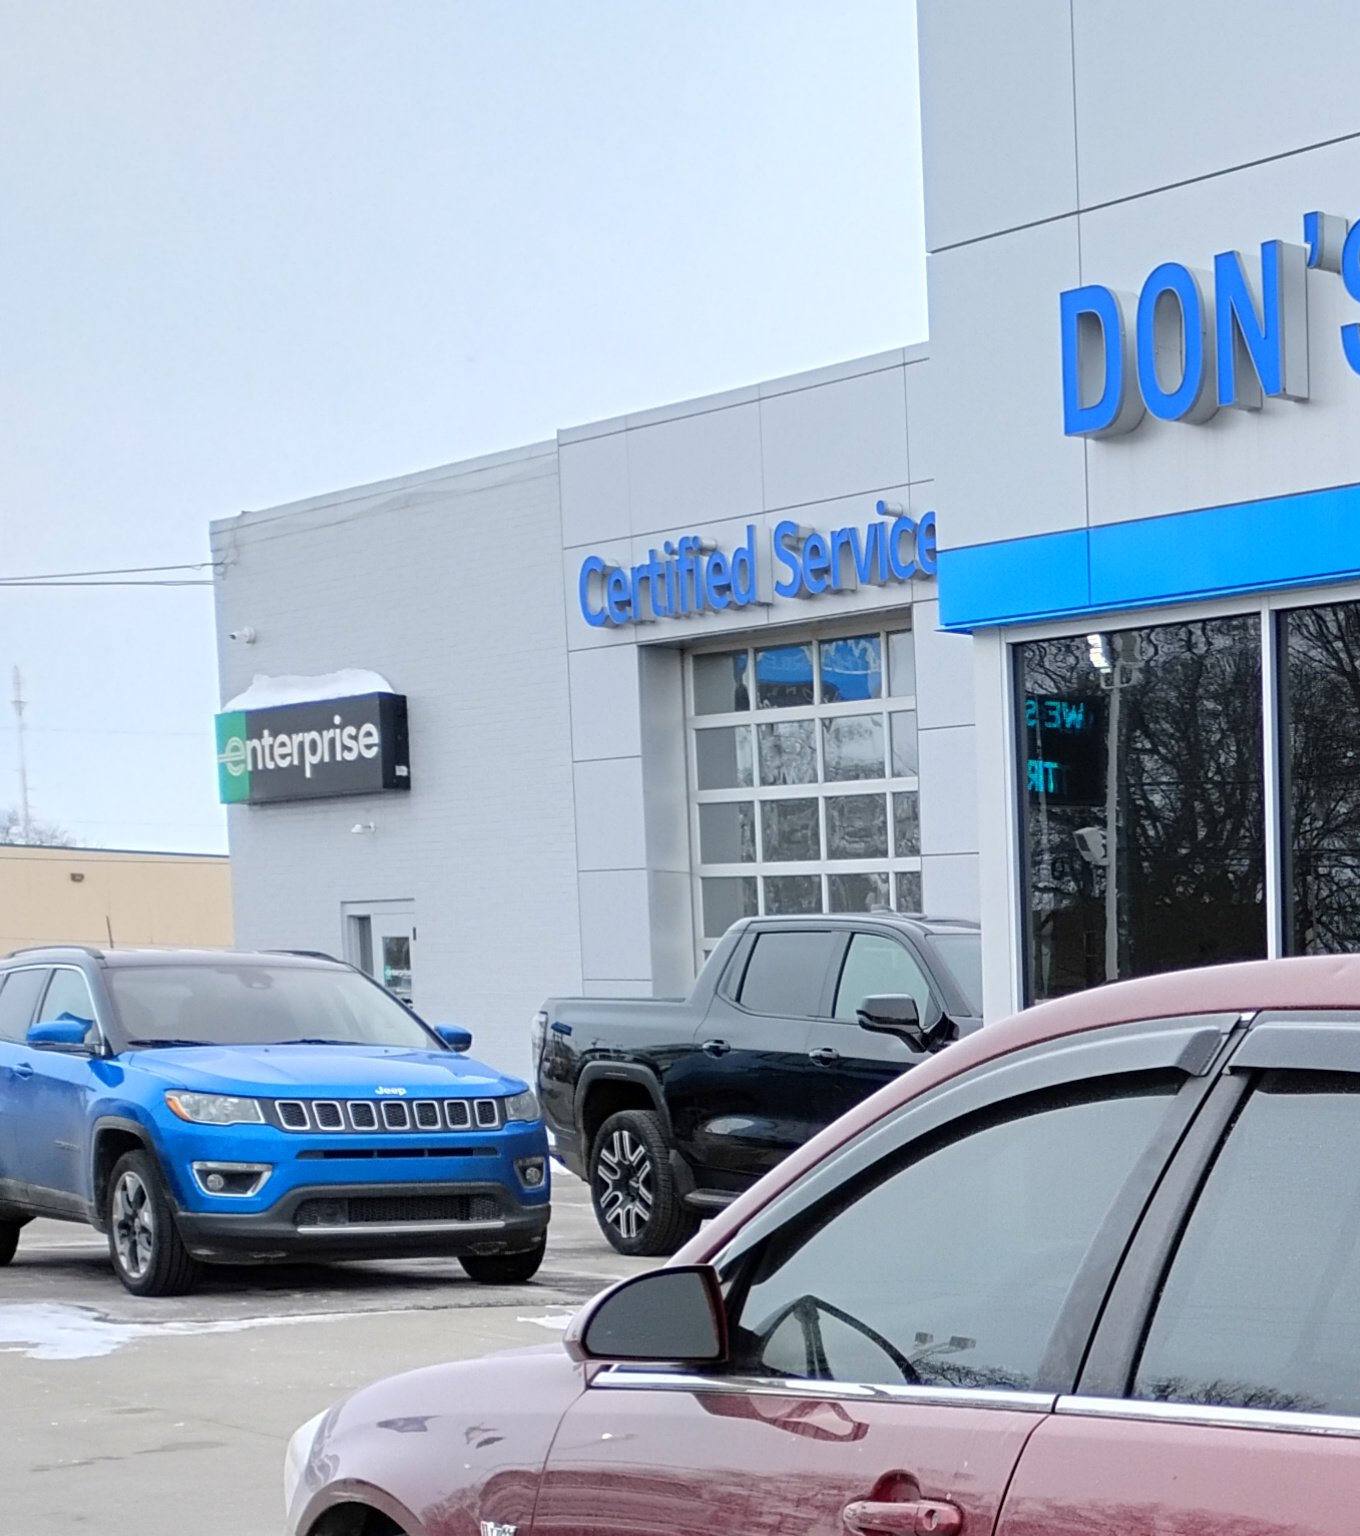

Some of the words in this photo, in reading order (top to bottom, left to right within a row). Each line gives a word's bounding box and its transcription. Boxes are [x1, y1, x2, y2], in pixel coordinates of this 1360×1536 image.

[579, 524, 757, 628] Certified
[773, 500, 937, 599] Service
[218, 714, 379, 779] enterprise
[375, 1086, 407, 1096] Jeep
